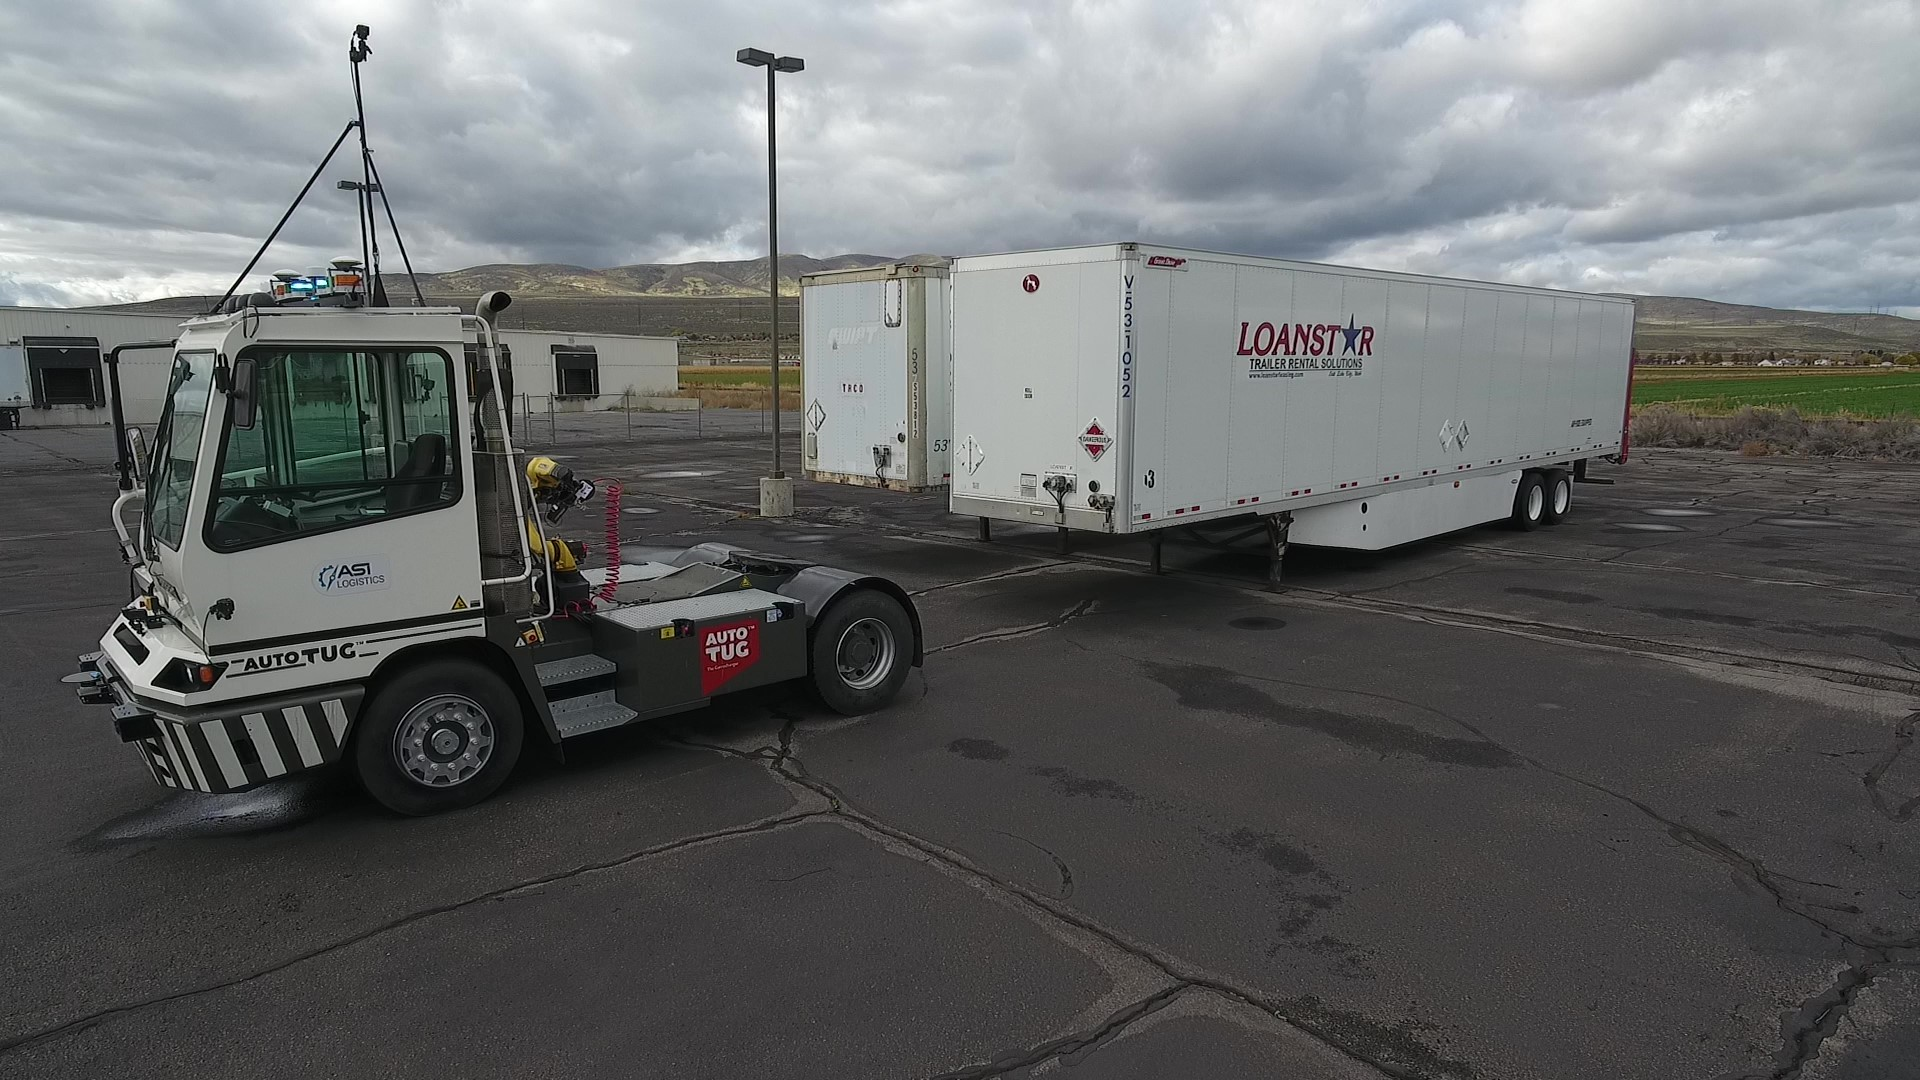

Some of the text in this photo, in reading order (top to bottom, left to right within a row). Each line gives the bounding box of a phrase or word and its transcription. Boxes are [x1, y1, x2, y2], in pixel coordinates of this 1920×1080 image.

[1122, 275, 1134, 398] V-53-1052
[1249, 358, 1363, 370] TRAILER RENTAL SOLUTIONS
[337, 562, 371, 579] ASI
[336, 574, 385, 589] LOGISTICS
[705, 640, 749, 663] TUG
